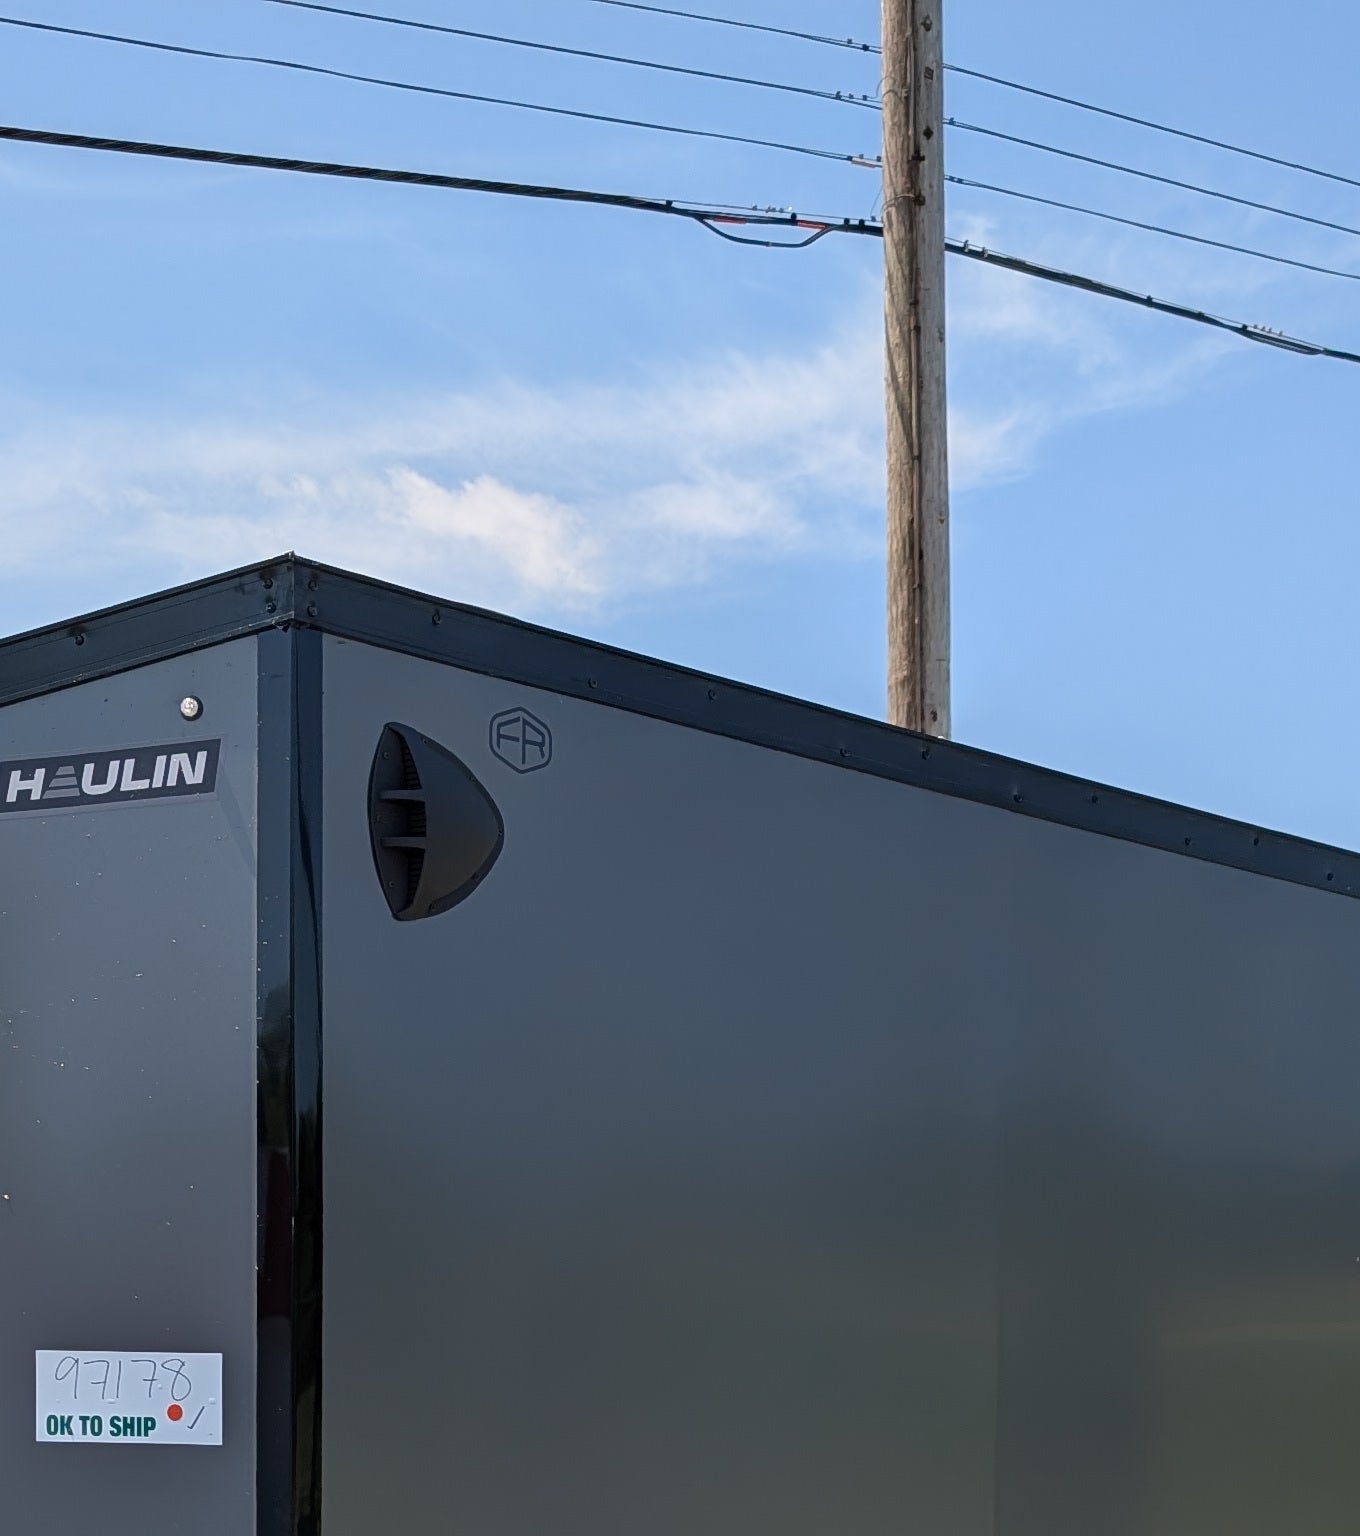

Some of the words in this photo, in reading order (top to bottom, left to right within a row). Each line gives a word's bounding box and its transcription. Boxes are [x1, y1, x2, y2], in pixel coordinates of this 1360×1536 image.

[55, 1356, 191, 1401] 97178
[46, 1414, 73, 1436] OK
[79, 1415, 103, 1436] TO
[109, 1416, 157, 1437] SHIP
